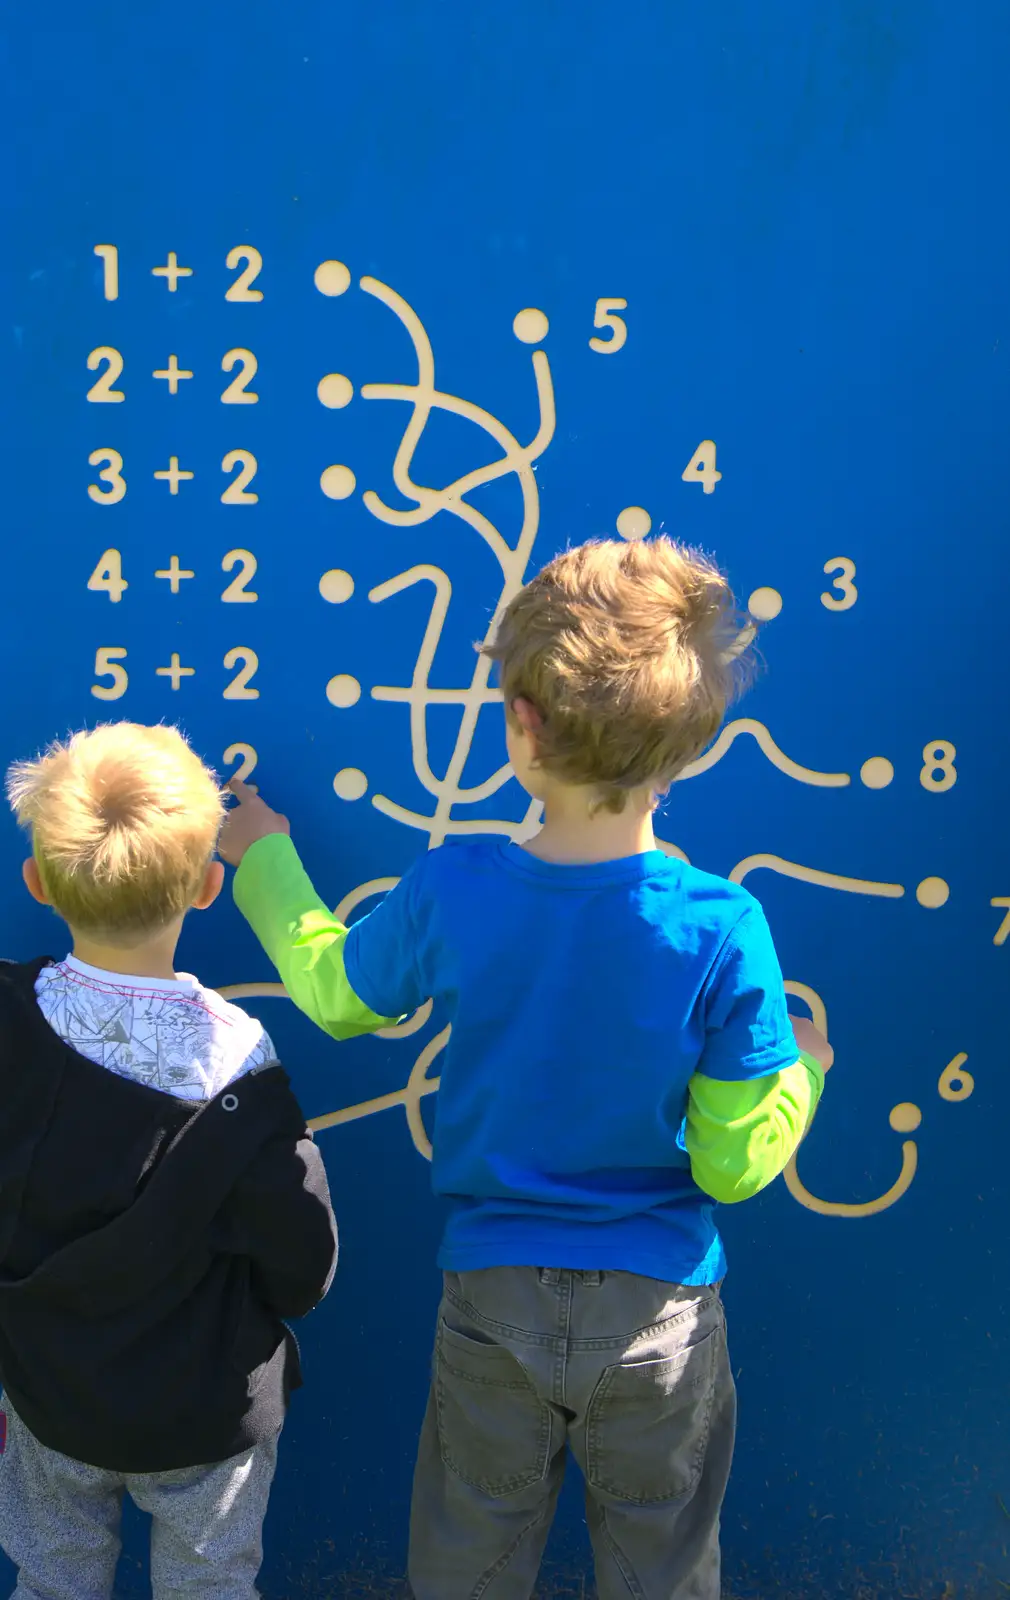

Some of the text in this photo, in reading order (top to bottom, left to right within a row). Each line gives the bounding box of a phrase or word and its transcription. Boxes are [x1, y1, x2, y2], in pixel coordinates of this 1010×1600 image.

[93, 244, 264, 303] 1 + 2
[588, 298, 628, 355] 5
[86, 346, 259, 405] 2 + 2
[87, 447, 259, 505] 3 + 2
[681, 439, 722, 495] 4
[87, 548, 258, 603] 4 + 2
[820, 556, 858, 611] 3
[90, 646, 260, 701] 5 + 2
[222, 742, 260, 793] 2
[919, 740, 957, 793] 8
[937, 1052, 975, 1102] 6
